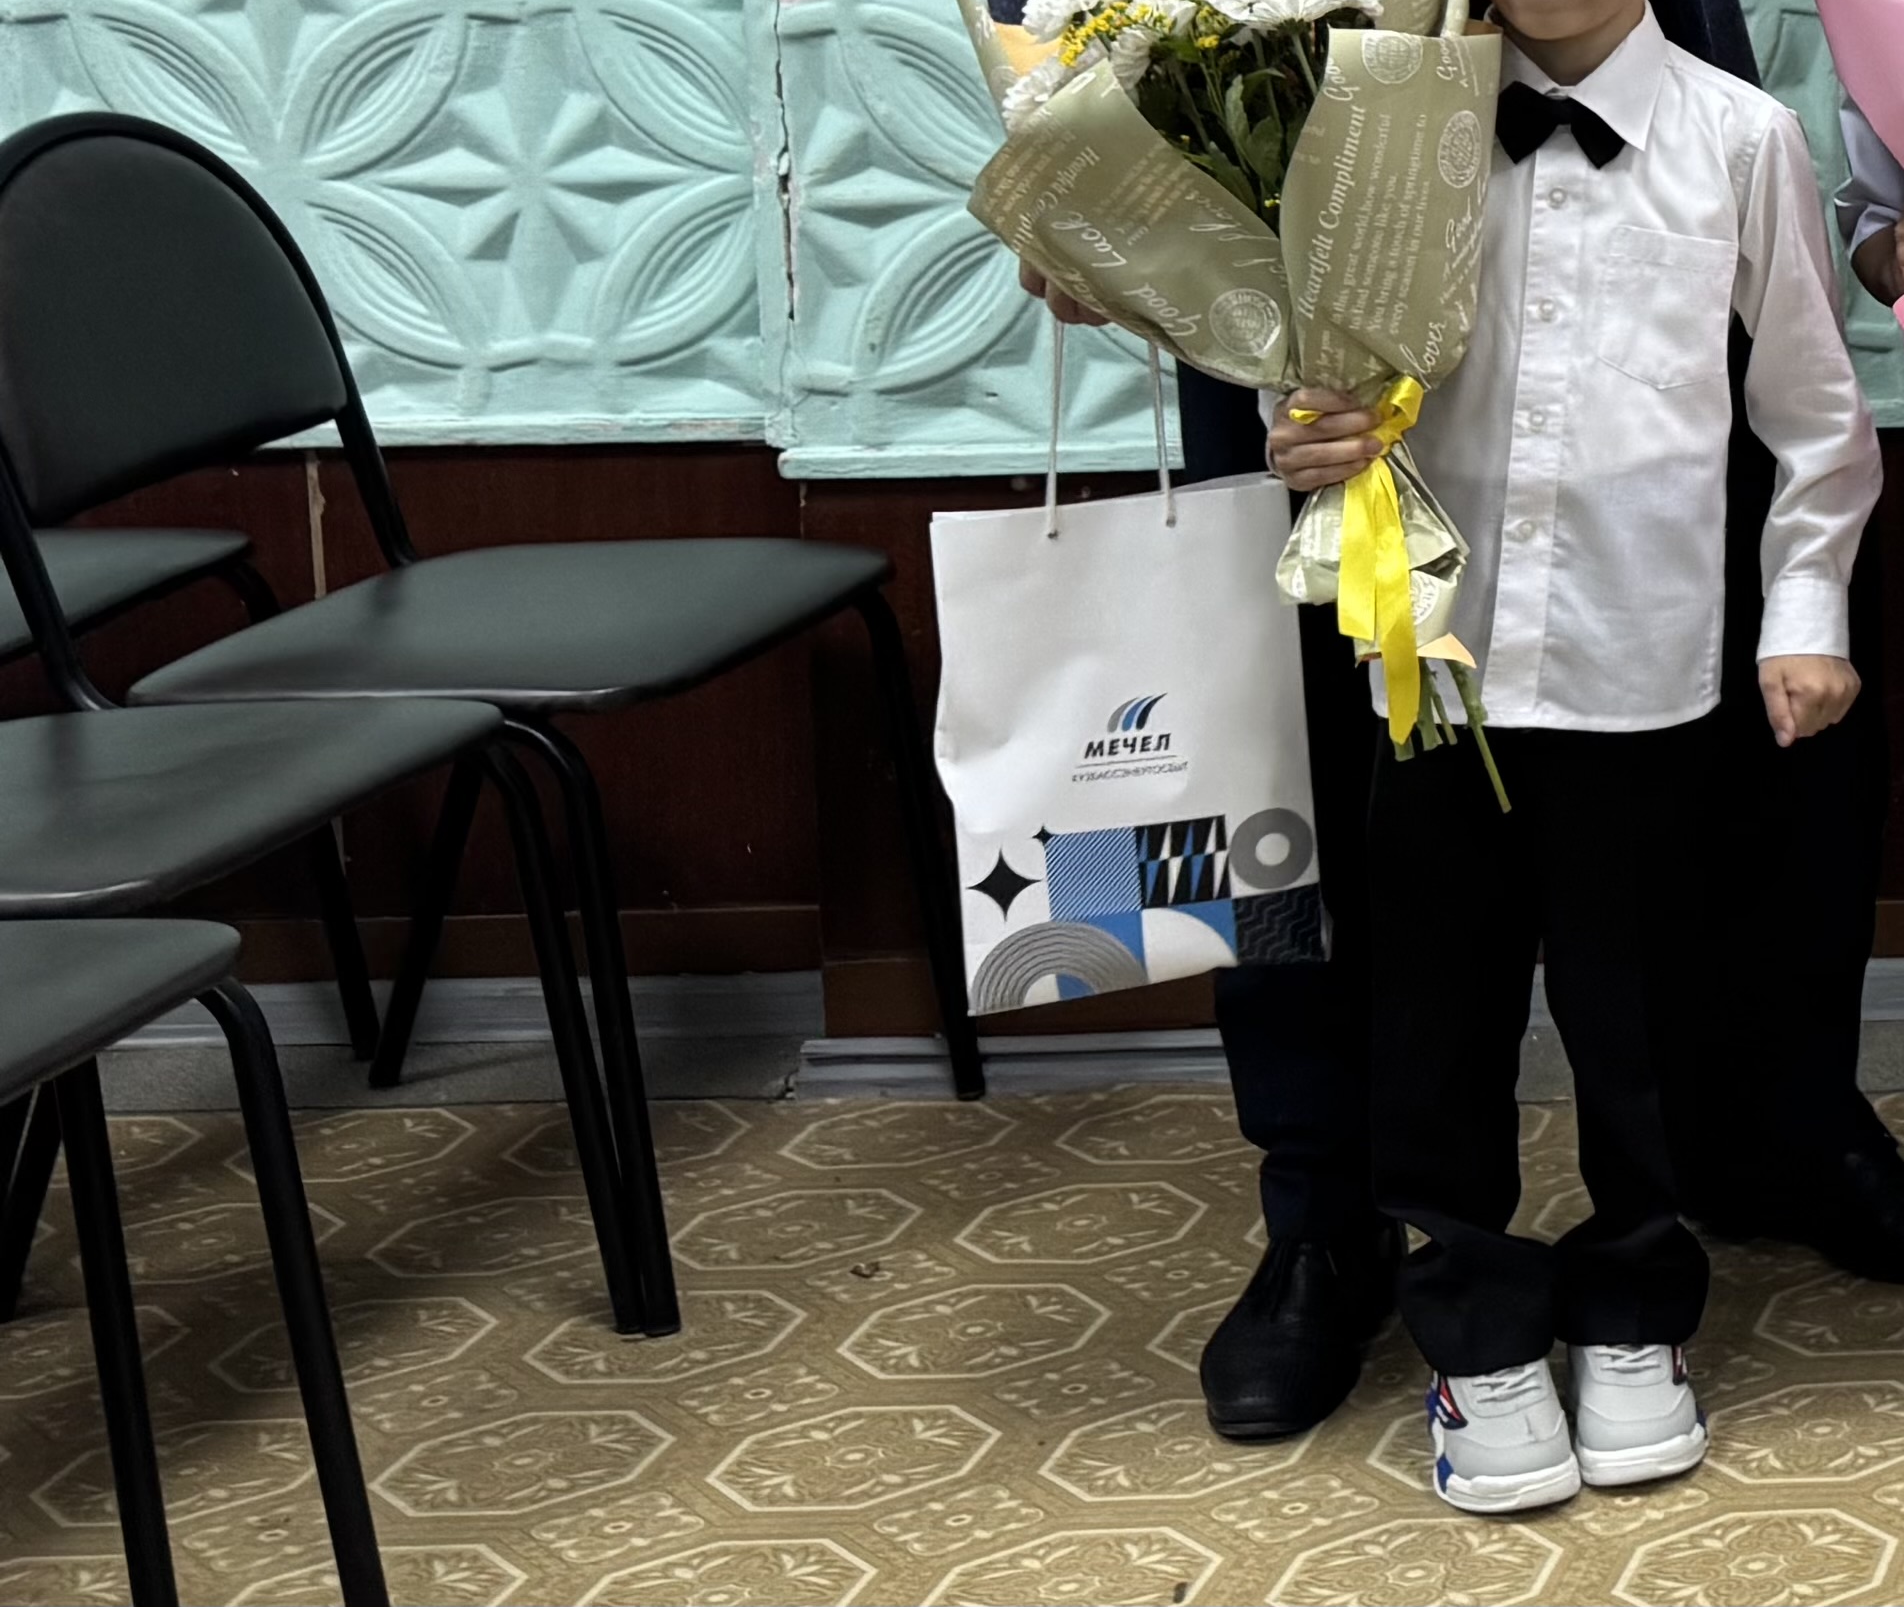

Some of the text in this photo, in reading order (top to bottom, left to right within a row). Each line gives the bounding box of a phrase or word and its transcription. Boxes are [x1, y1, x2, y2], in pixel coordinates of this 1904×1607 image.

[1370, 114, 1392, 180] wonderful
[1051, 211, 1127, 267] Luck
[1298, 105, 1366, 321] Heartfelt Compliment
[1123, 282, 1202, 337] Good
[1084, 733, 1172, 759] МЕЧЕЛ
